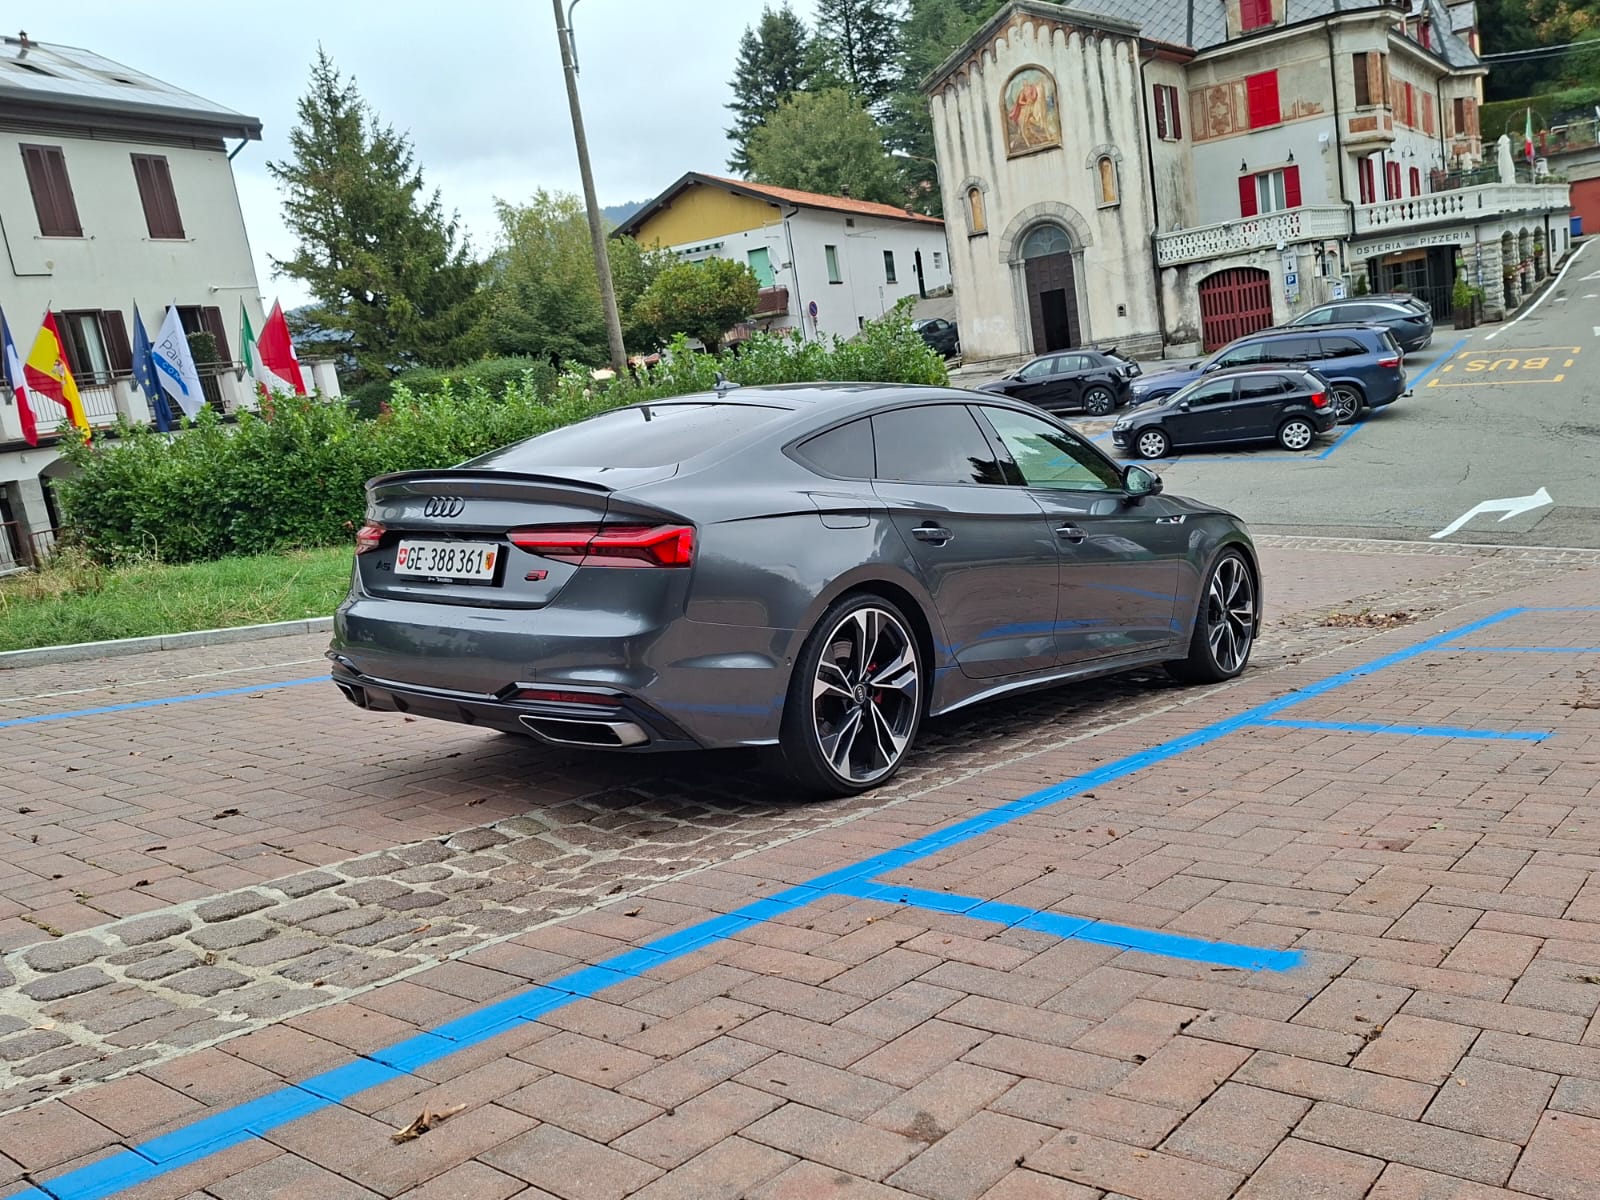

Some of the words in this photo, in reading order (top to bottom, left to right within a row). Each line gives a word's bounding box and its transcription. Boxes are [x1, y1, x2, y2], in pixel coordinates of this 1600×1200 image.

[1356, 242, 1402, 255] OSTERIA
[1420, 231, 1471, 245] PIZZERIA
[1464, 357, 1550, 372] BUS
[375, 560, 391, 571] A5
